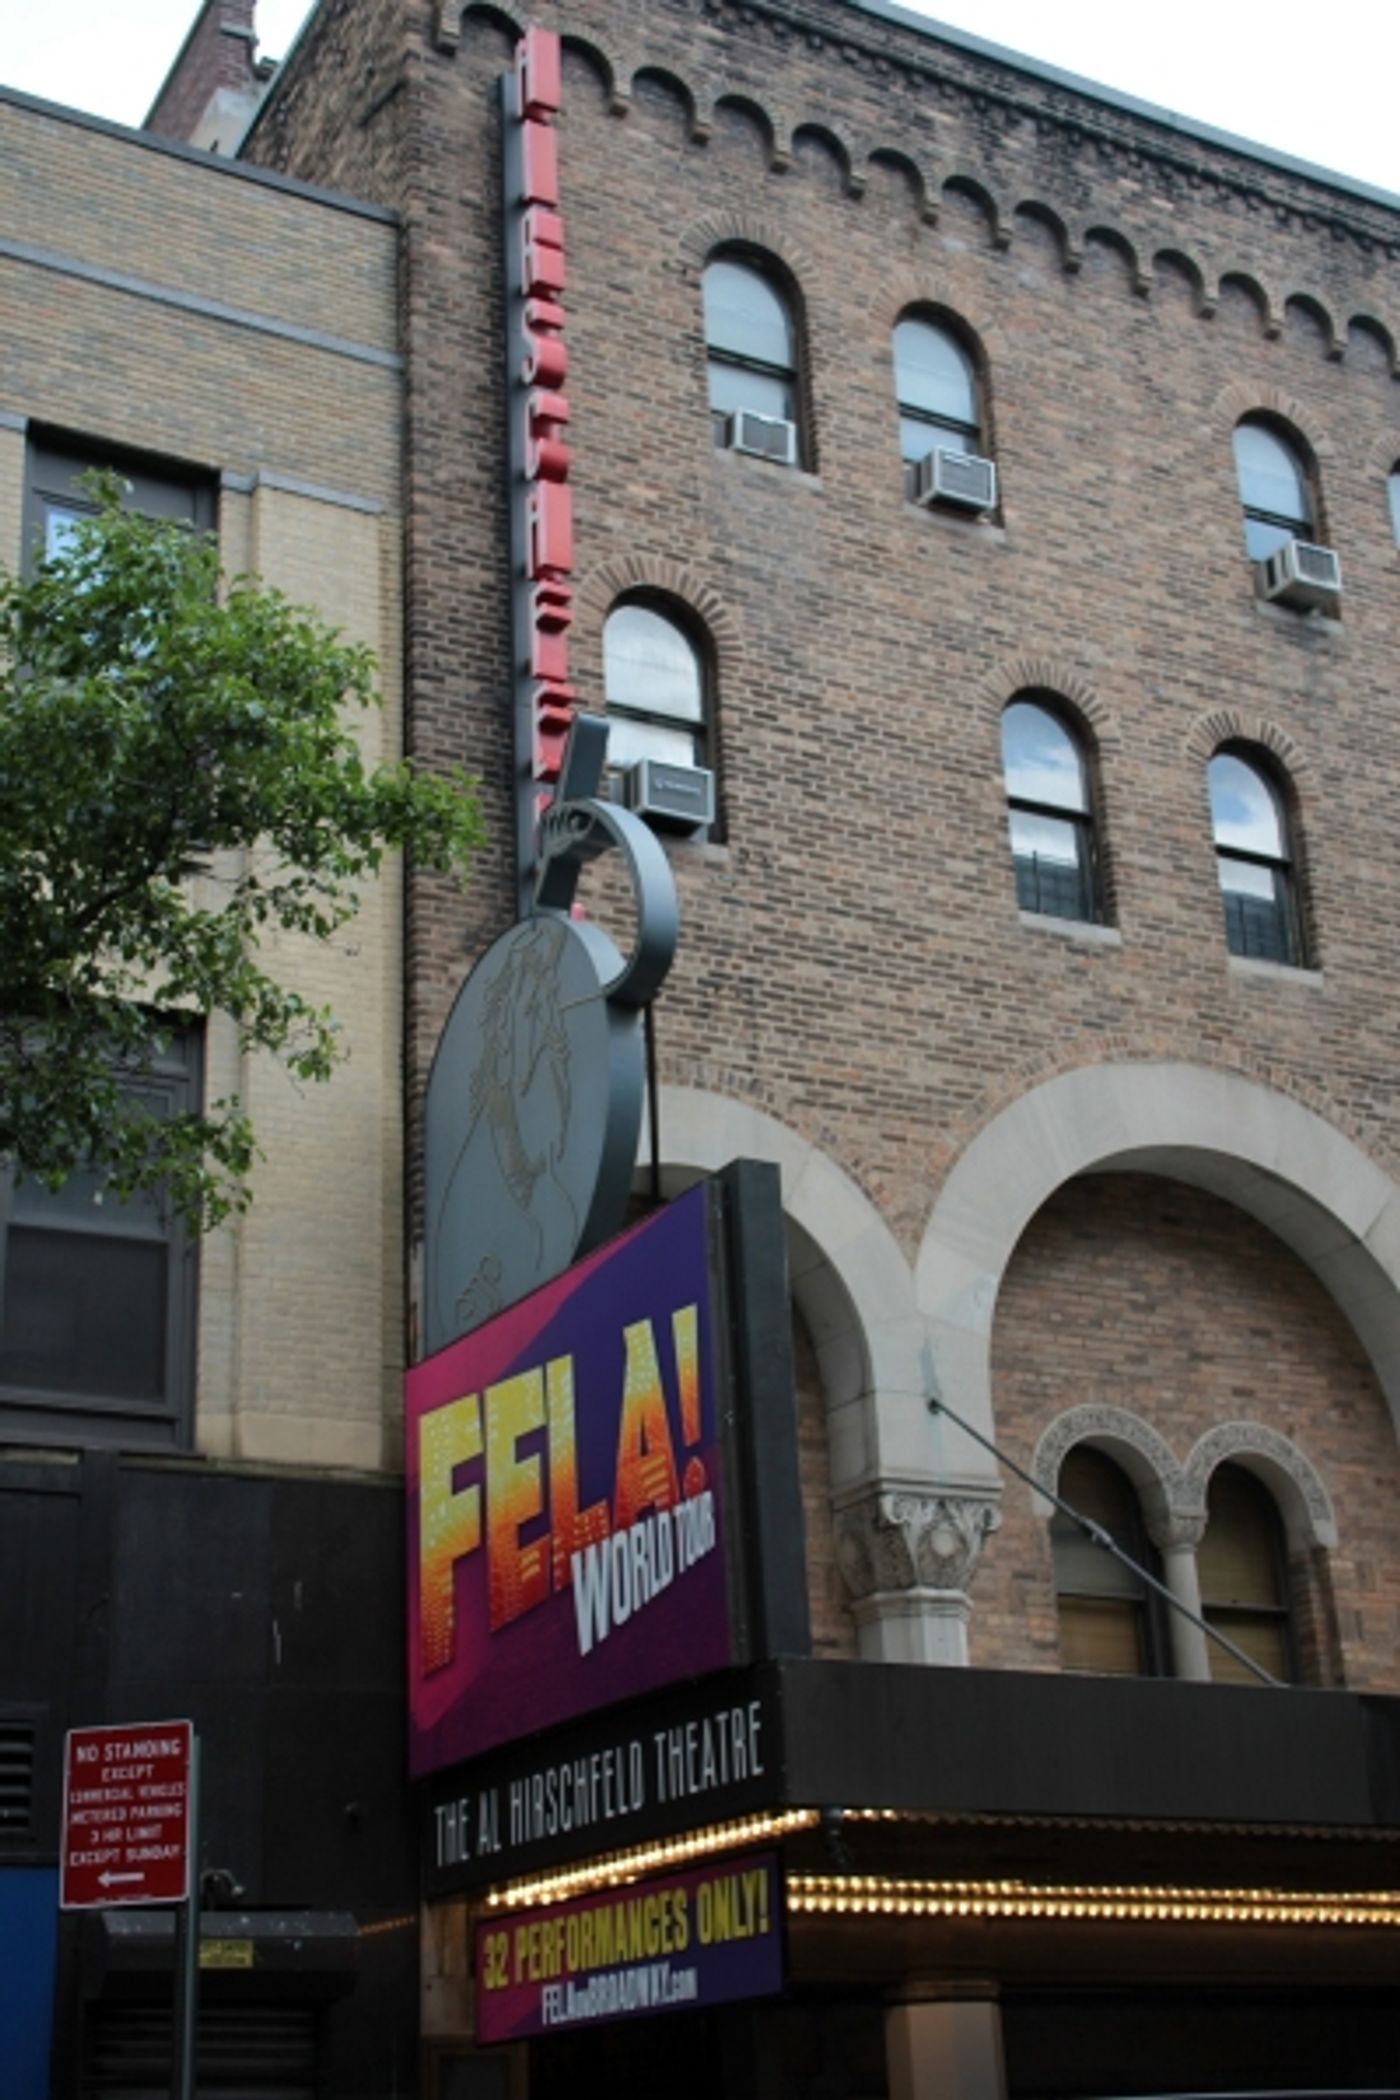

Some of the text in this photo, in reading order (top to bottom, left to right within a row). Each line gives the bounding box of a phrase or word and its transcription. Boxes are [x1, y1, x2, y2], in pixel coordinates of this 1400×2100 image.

[419, 1303, 707, 1678] FELA!
[571, 1489, 715, 1656] WORLD TOUR
[77, 1740, 182, 1762] NO STANDING
[102, 1764, 154, 1781] EXCEPT
[434, 1701, 764, 1868] THE AL HIRSCHFELD THEATRE
[130, 1803, 183, 1820] PARKING
[102, 1827, 122, 1842] HR
[126, 1824, 162, 1841] LIMIT
[70, 1844, 181, 1867] EXCEPT SUNDAY
[483, 1868, 769, 1990] 32 PERFORMANCES ONLY!
